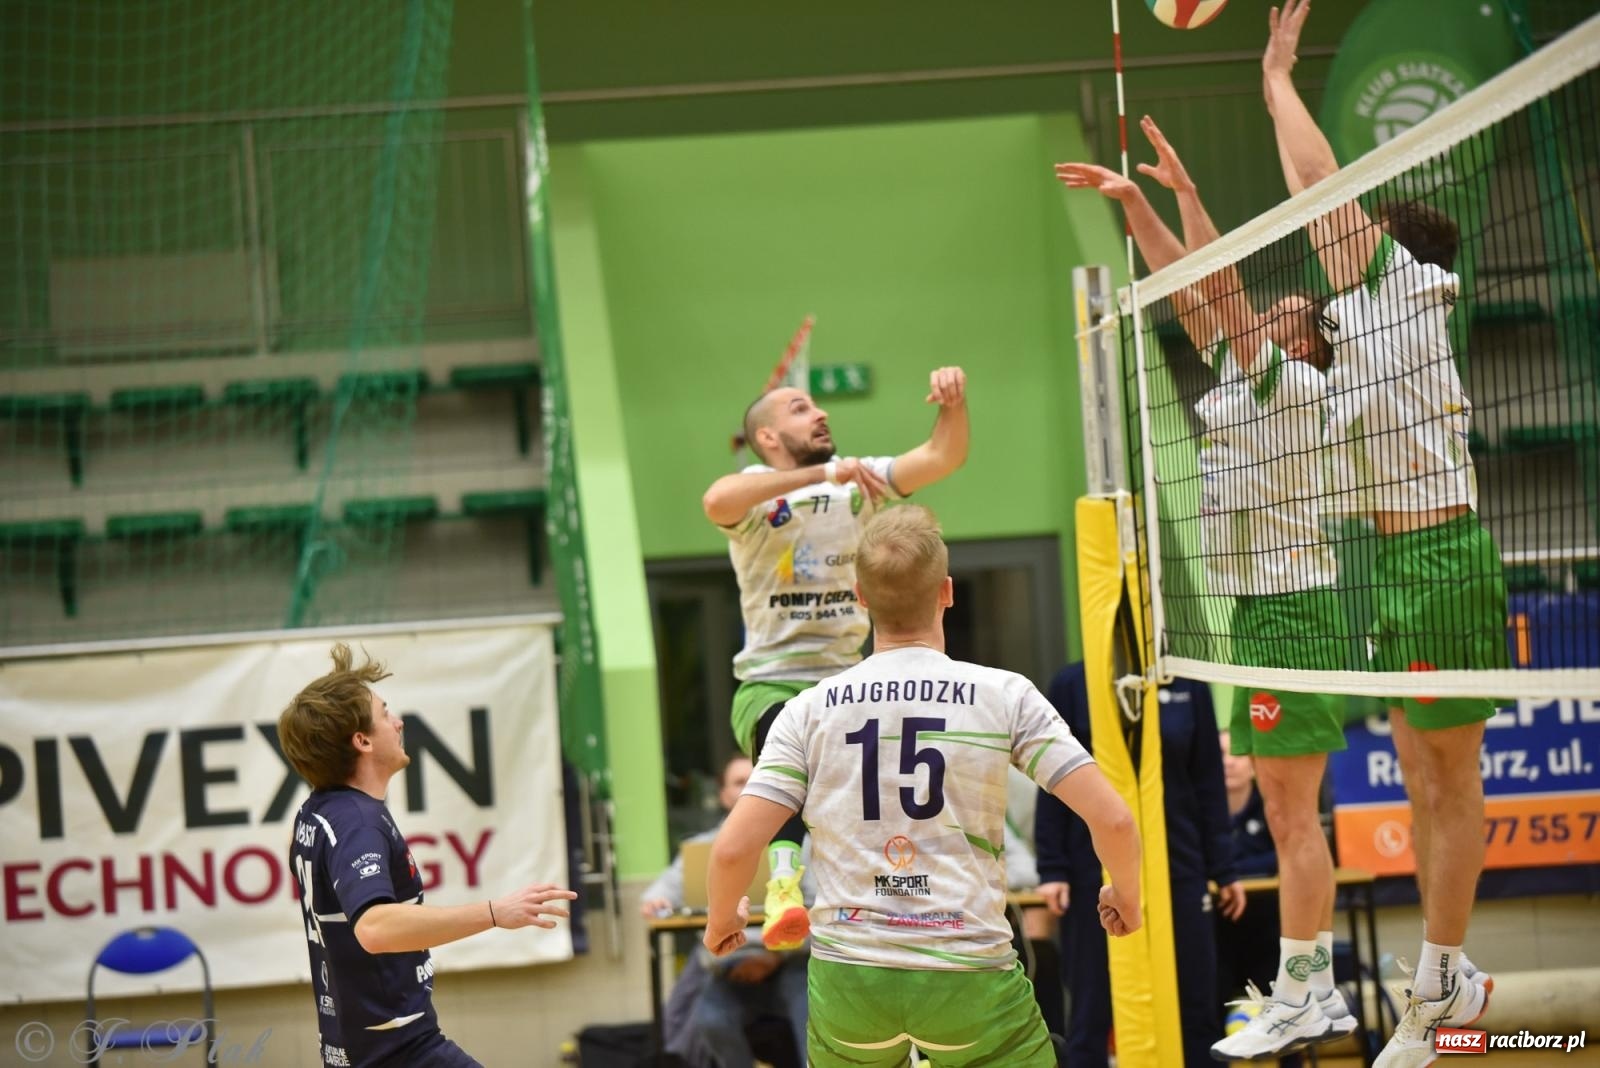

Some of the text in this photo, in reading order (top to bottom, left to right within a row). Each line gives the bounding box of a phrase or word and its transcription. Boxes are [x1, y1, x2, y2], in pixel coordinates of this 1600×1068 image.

[811, 495, 830, 514] 77
[769, 592, 822, 608] POMPY
[825, 679, 976, 708] NAJGRODZKI
[845, 716, 946, 821] 15
[1548, 738, 1593, 776] ul.
[0, 707, 495, 840] IVEXN
[1529, 812, 1570, 844] 55
[2, 828, 494, 923] ECHNOGY
[874, 874, 929, 889] MK SPORT
[875, 888, 931, 897] FOUNDATION
